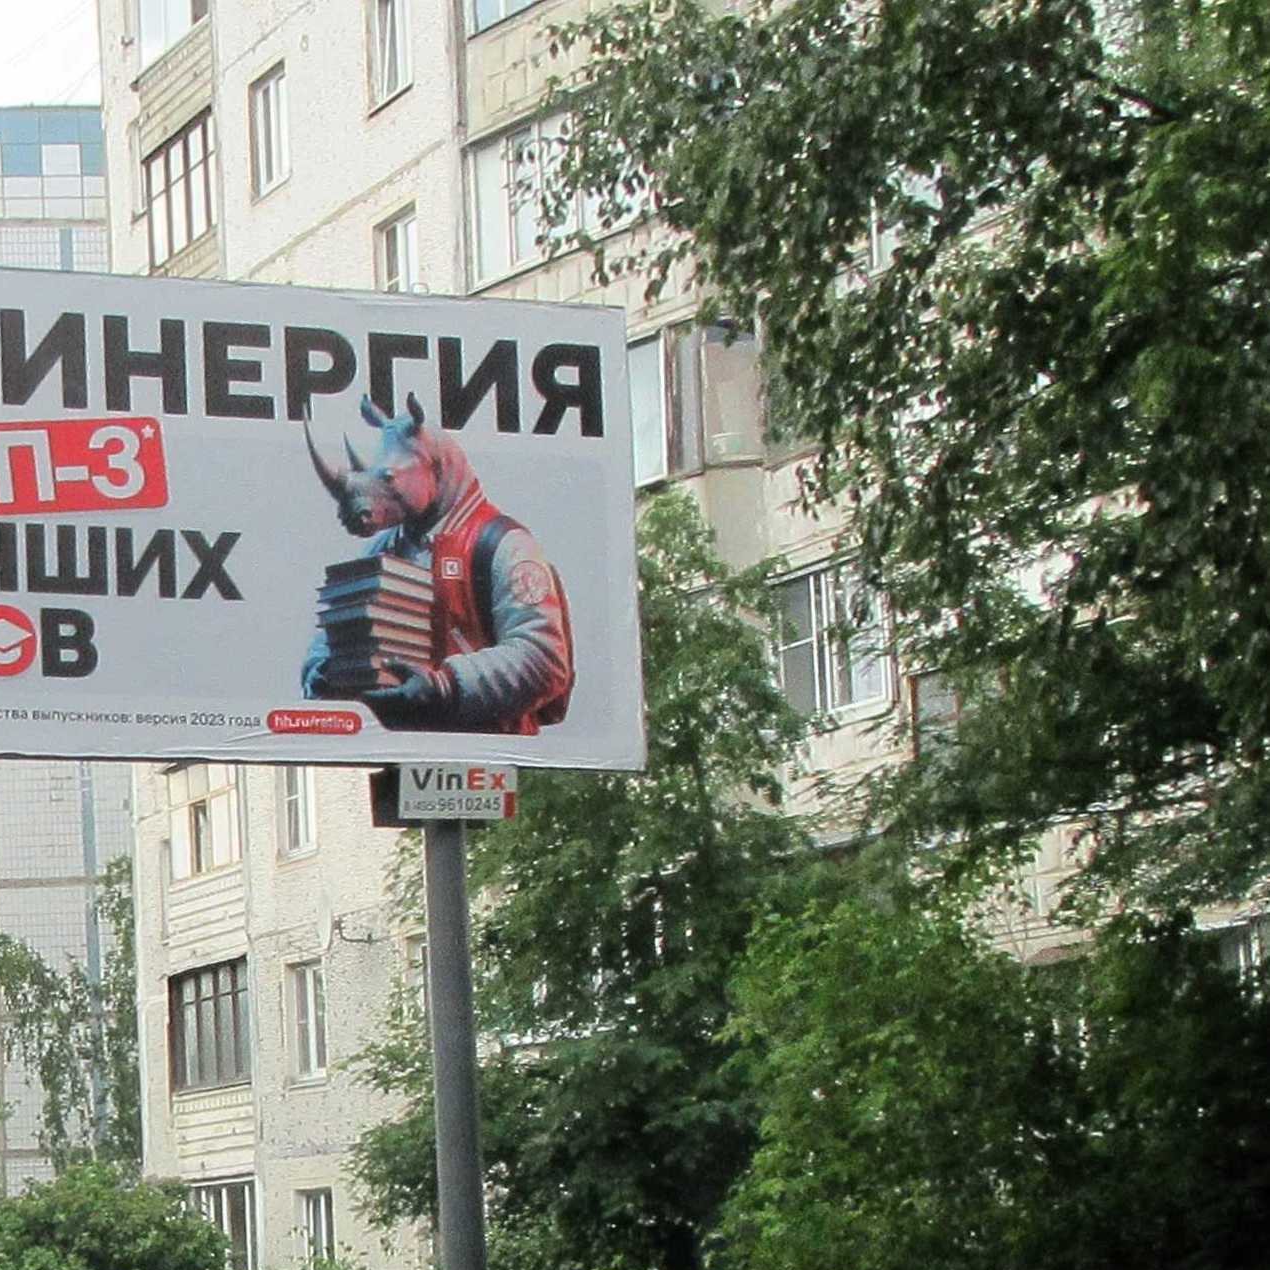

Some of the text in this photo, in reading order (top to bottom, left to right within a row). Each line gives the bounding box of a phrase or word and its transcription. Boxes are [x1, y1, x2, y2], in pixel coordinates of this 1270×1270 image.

[32, 708, 133, 724] выпускников:
[136, 713, 187, 727] версия
[190, 712, 226, 726] 2023
[228, 715, 261, 727] года
[273, 714, 355, 732] hh.ru/rating
[410, 766, 507, 792] VinEx
